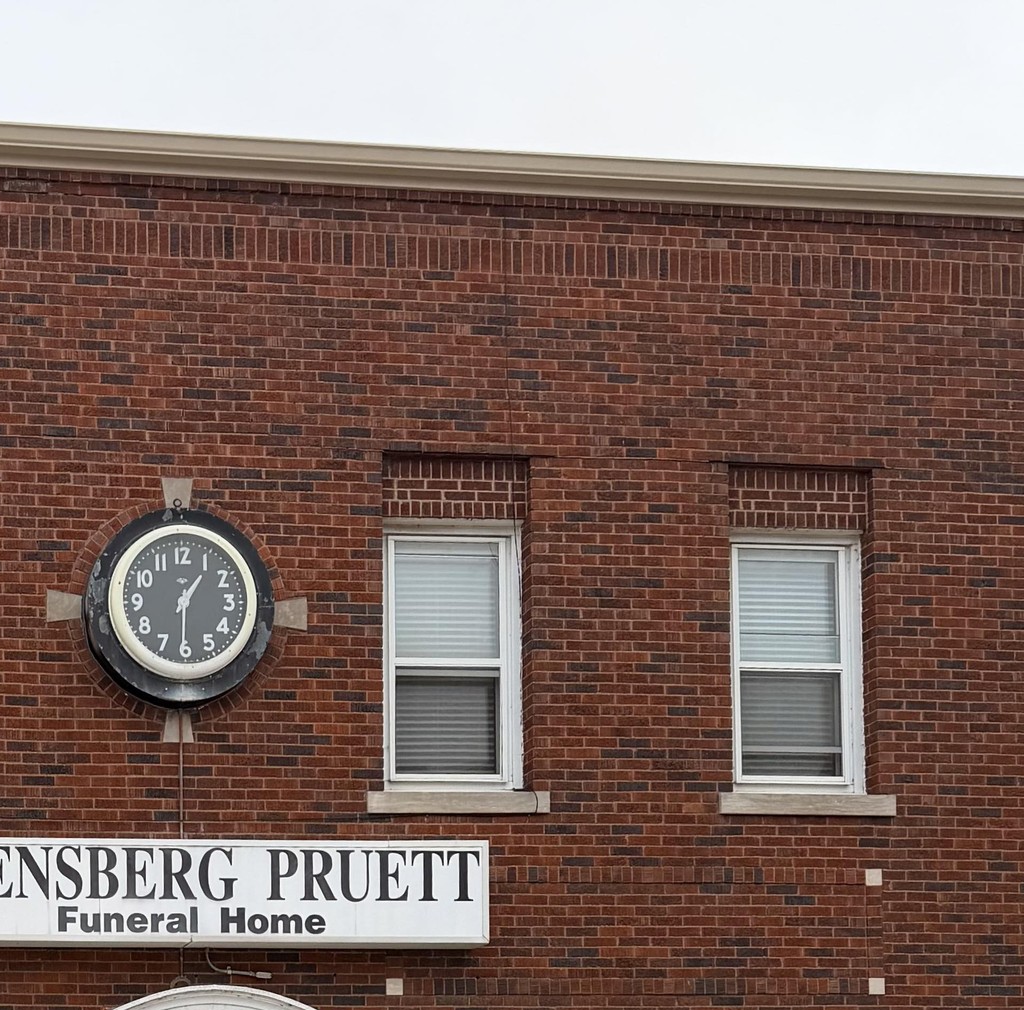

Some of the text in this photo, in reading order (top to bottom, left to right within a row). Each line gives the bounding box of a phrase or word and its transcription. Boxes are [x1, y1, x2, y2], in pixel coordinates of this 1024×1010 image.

[154, 553, 167, 572] 11
[174, 546, 192, 565] 12
[202, 553, 208, 572] 1
[136, 569, 153, 589] 10
[216, 569, 230, 588] 2
[131, 592, 144, 612] 9
[222, 593, 236, 612] 3
[138, 615, 151, 635] 8
[215, 616, 230, 635] 4
[157, 633, 170, 652] 7
[179, 640, 192, 658] 6
[202, 633, 215, 652] 5
[266, 849, 480, 903] PRUETT
[57, 906, 327, 935] Funeral Home
